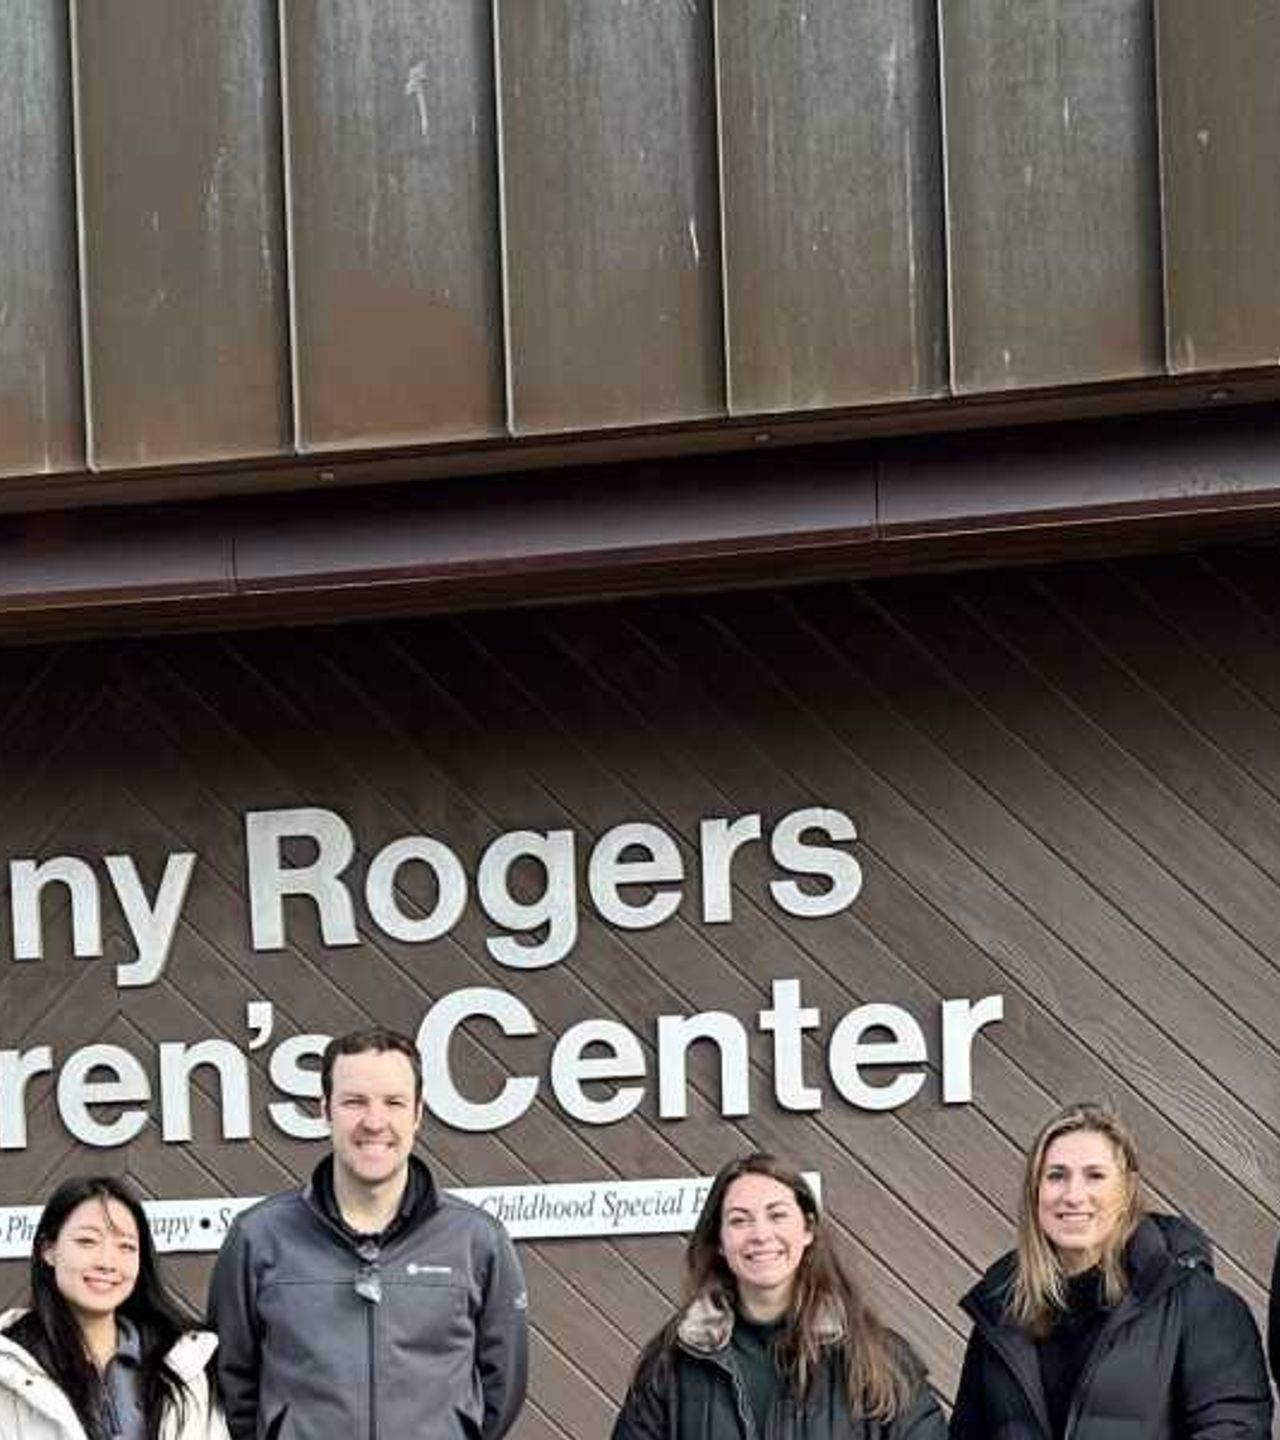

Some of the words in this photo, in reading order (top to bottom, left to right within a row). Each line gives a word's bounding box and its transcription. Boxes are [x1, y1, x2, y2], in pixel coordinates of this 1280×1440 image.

[245, 807, 864, 969] Rogers
[417, 979, 1003, 1131] Center
[601, 1187, 685, 1226] Special
